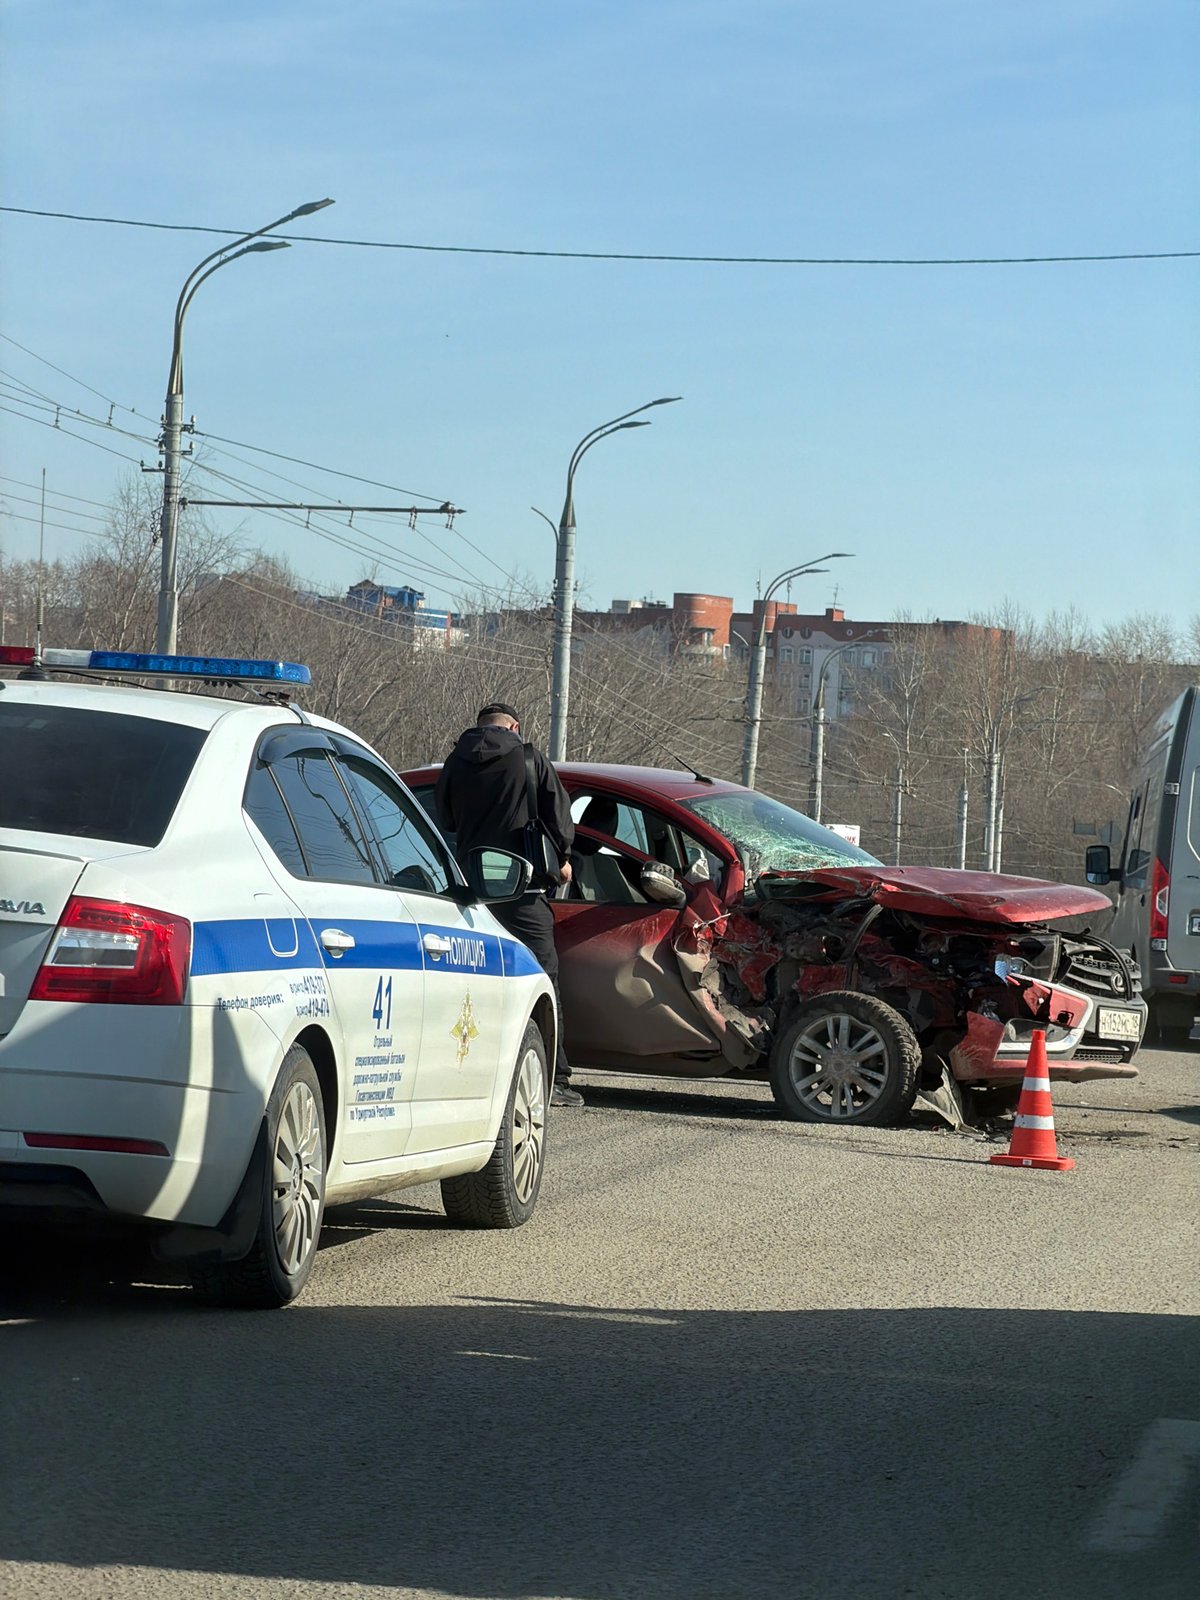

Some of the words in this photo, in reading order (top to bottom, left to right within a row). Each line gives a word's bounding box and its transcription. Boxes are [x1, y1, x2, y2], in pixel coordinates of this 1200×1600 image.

[444, 936, 486, 972] ПОЛИЦИЯ
[217, 995, 249, 1012] Телефон
[250, 993, 285, 1009] доверия:
[372, 975, 393, 1030] 41
